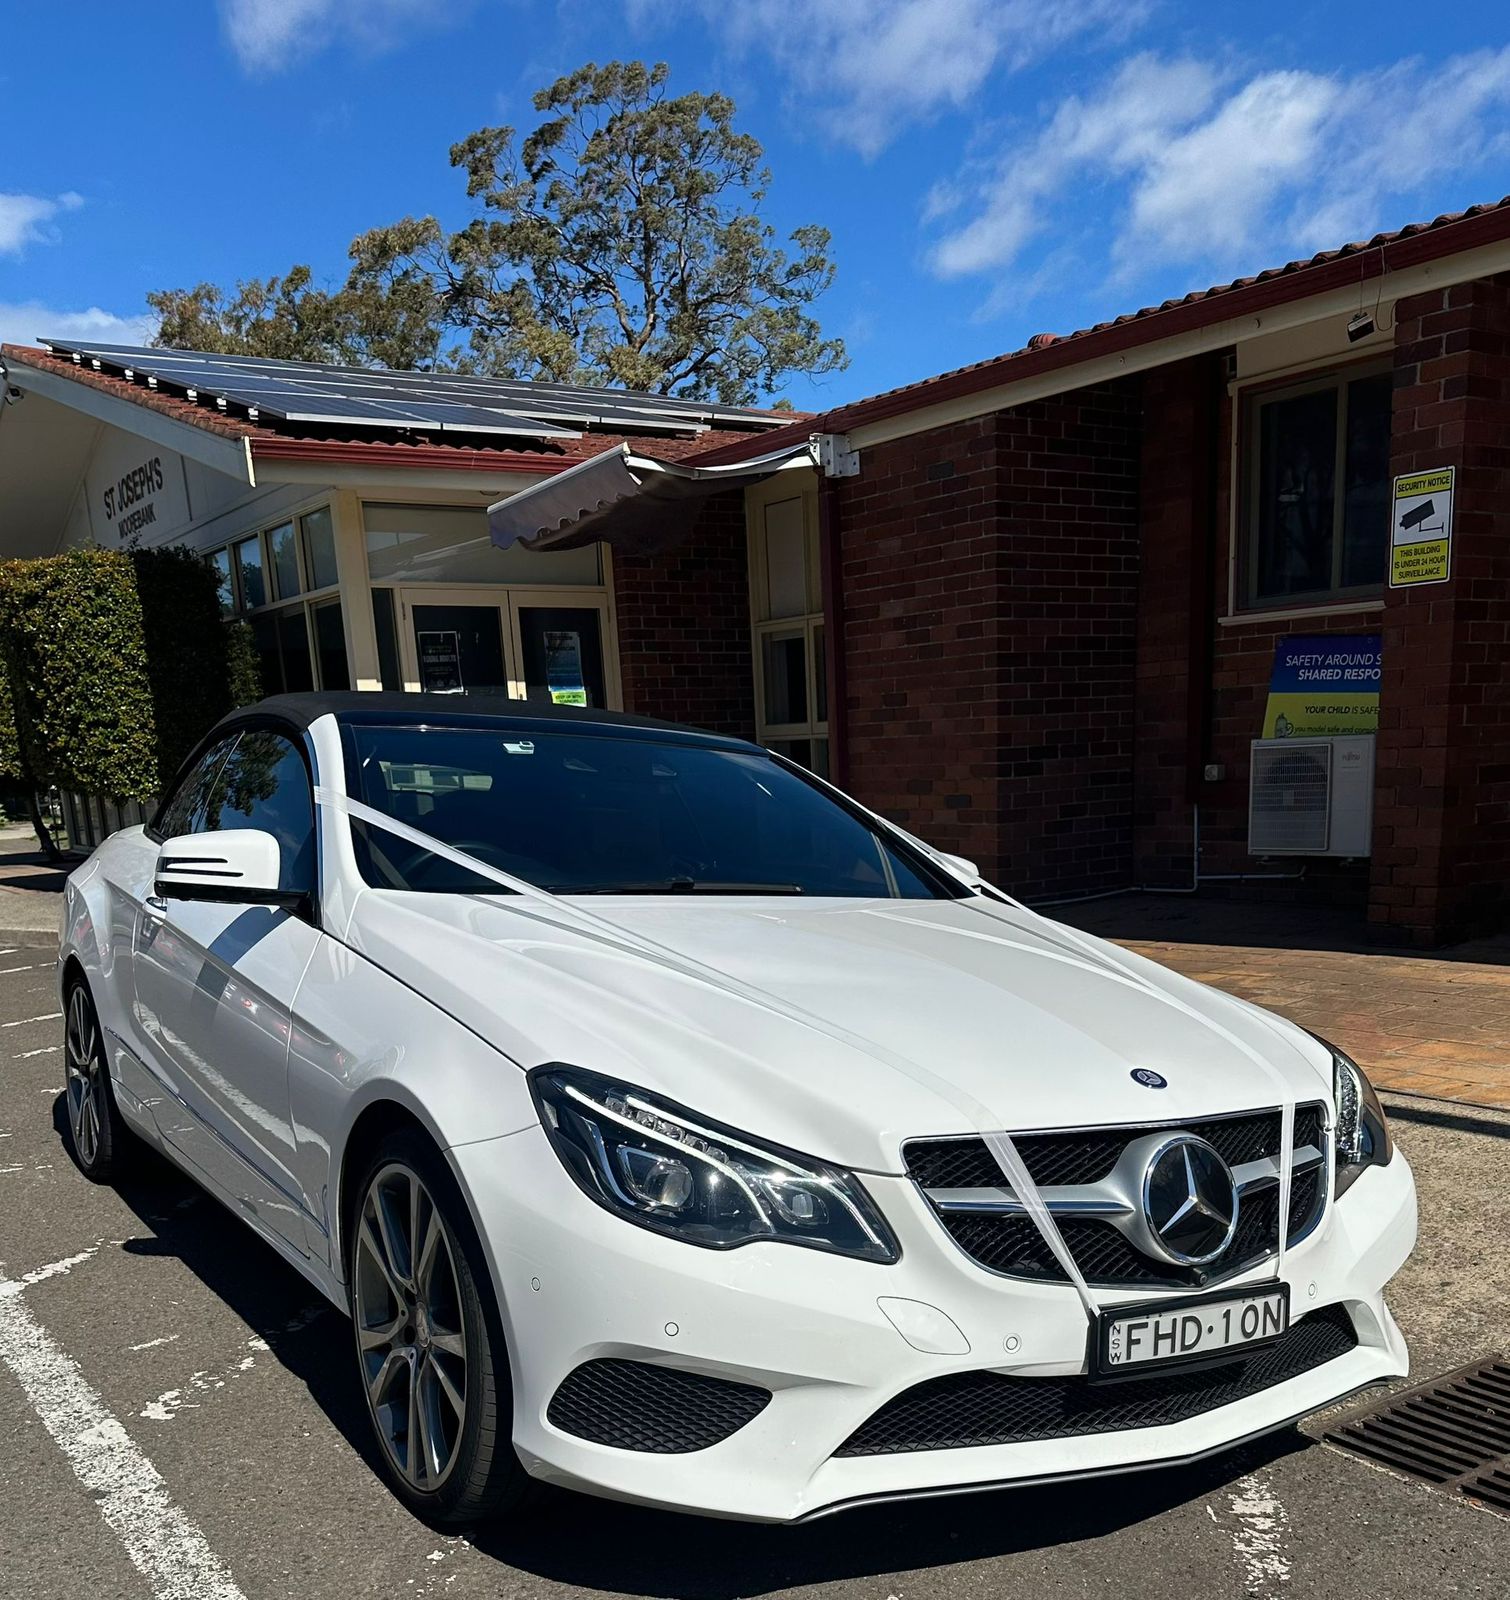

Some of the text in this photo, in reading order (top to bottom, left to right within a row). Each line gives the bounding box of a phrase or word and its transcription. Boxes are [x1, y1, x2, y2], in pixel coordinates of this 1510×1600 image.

[103, 457, 163, 520] ST JOSEPH'S
[1397, 475, 1450, 492] SECURITY NOTICE
[1400, 545, 1440, 557] THIS BUILDING
[1394, 555, 1446, 569] IS UNDER 24 HOUR
[1398, 567, 1440, 579] SURVEILLANCE
[1286, 654, 1324, 666] SAFETY
[1325, 653, 1374, 666] AROUND
[1298, 668, 1381, 680] SHARED RESPO
[1305, 706, 1326, 714] YOUR
[1327, 706, 1350, 714] CHILD
[1352, 706, 1358, 715] IS
